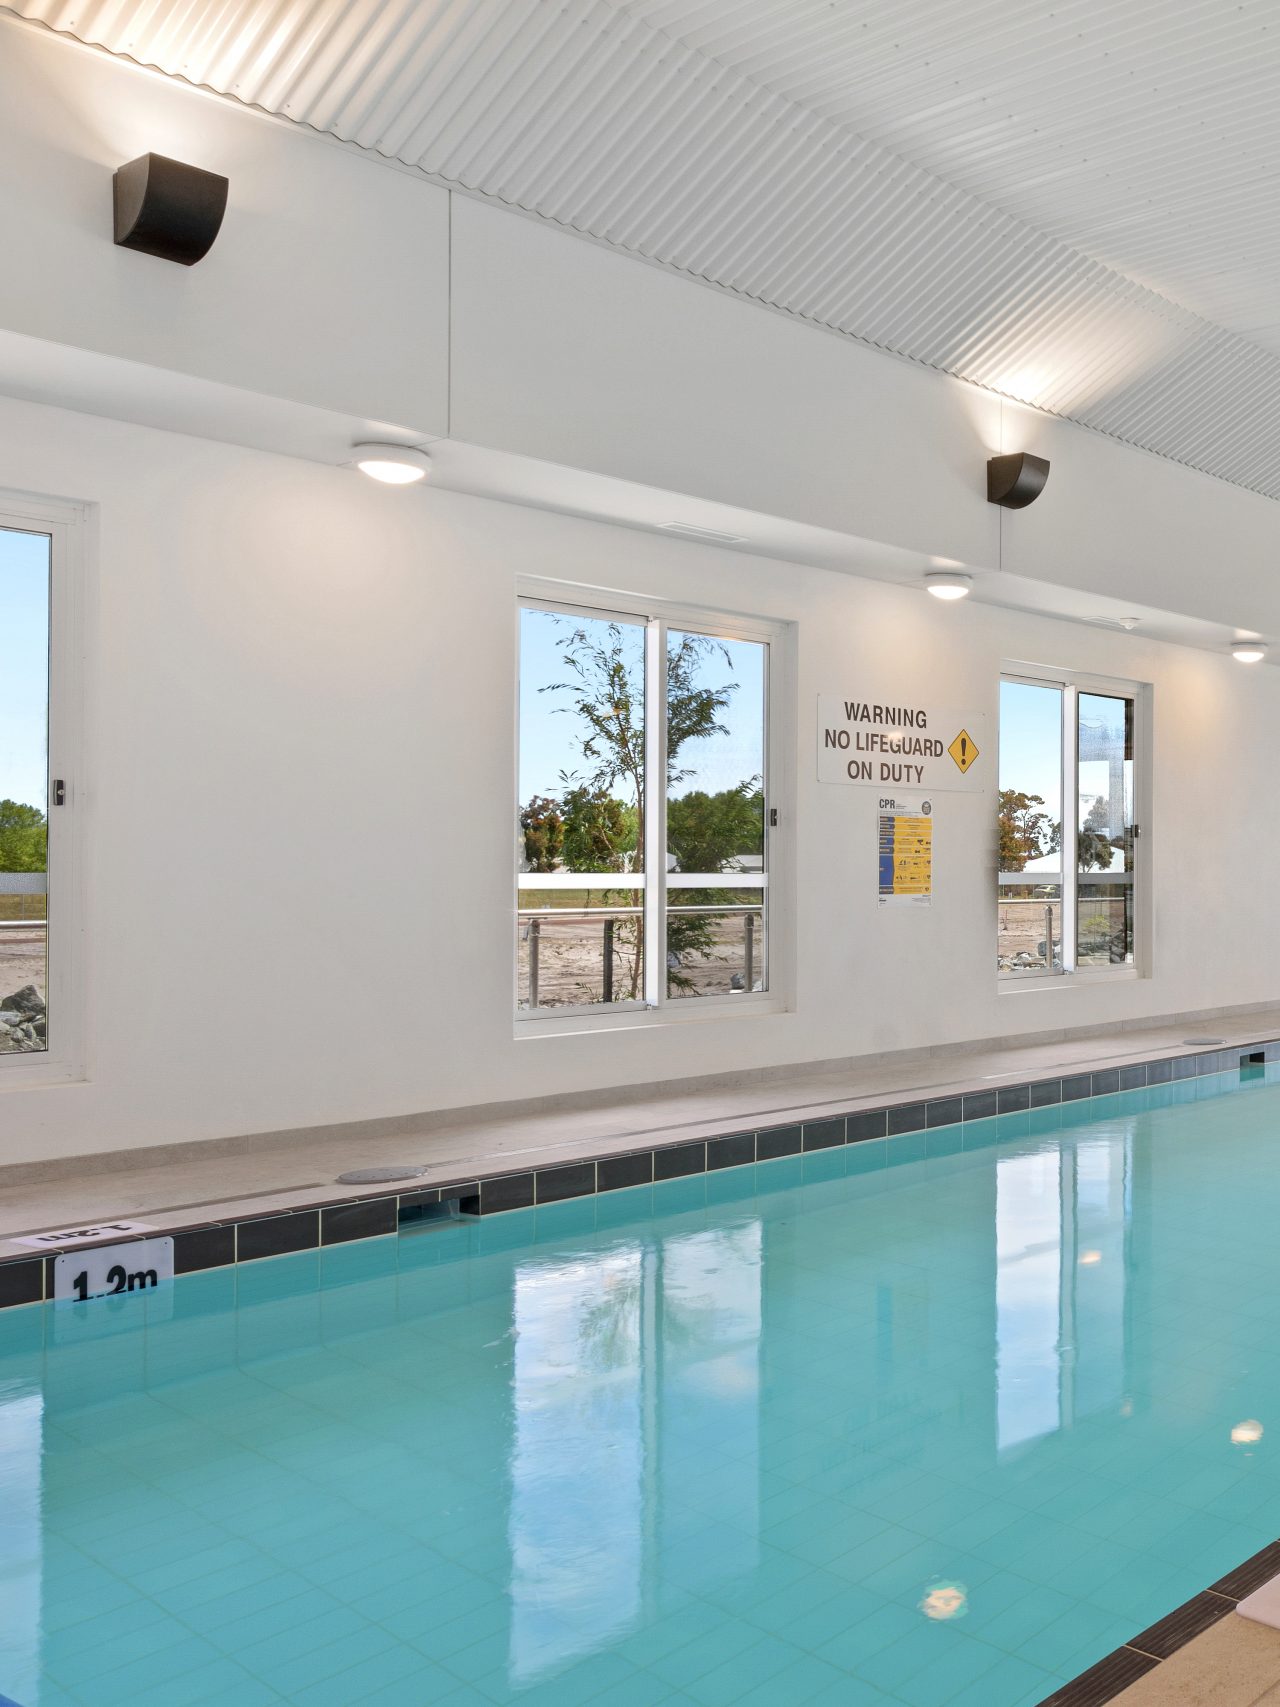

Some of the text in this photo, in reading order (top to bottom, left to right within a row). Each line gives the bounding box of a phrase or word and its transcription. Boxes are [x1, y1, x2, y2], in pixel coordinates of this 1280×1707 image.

[844, 701, 927, 729] WARNING
[824, 728, 944, 758] NO LIFEGUARD
[847, 759, 924, 784] ON DUTY
[879, 798, 895, 809] CPR
[35, 1224, 132, 1242] 1.2m
[72, 1264, 158, 1302] 1.2m
